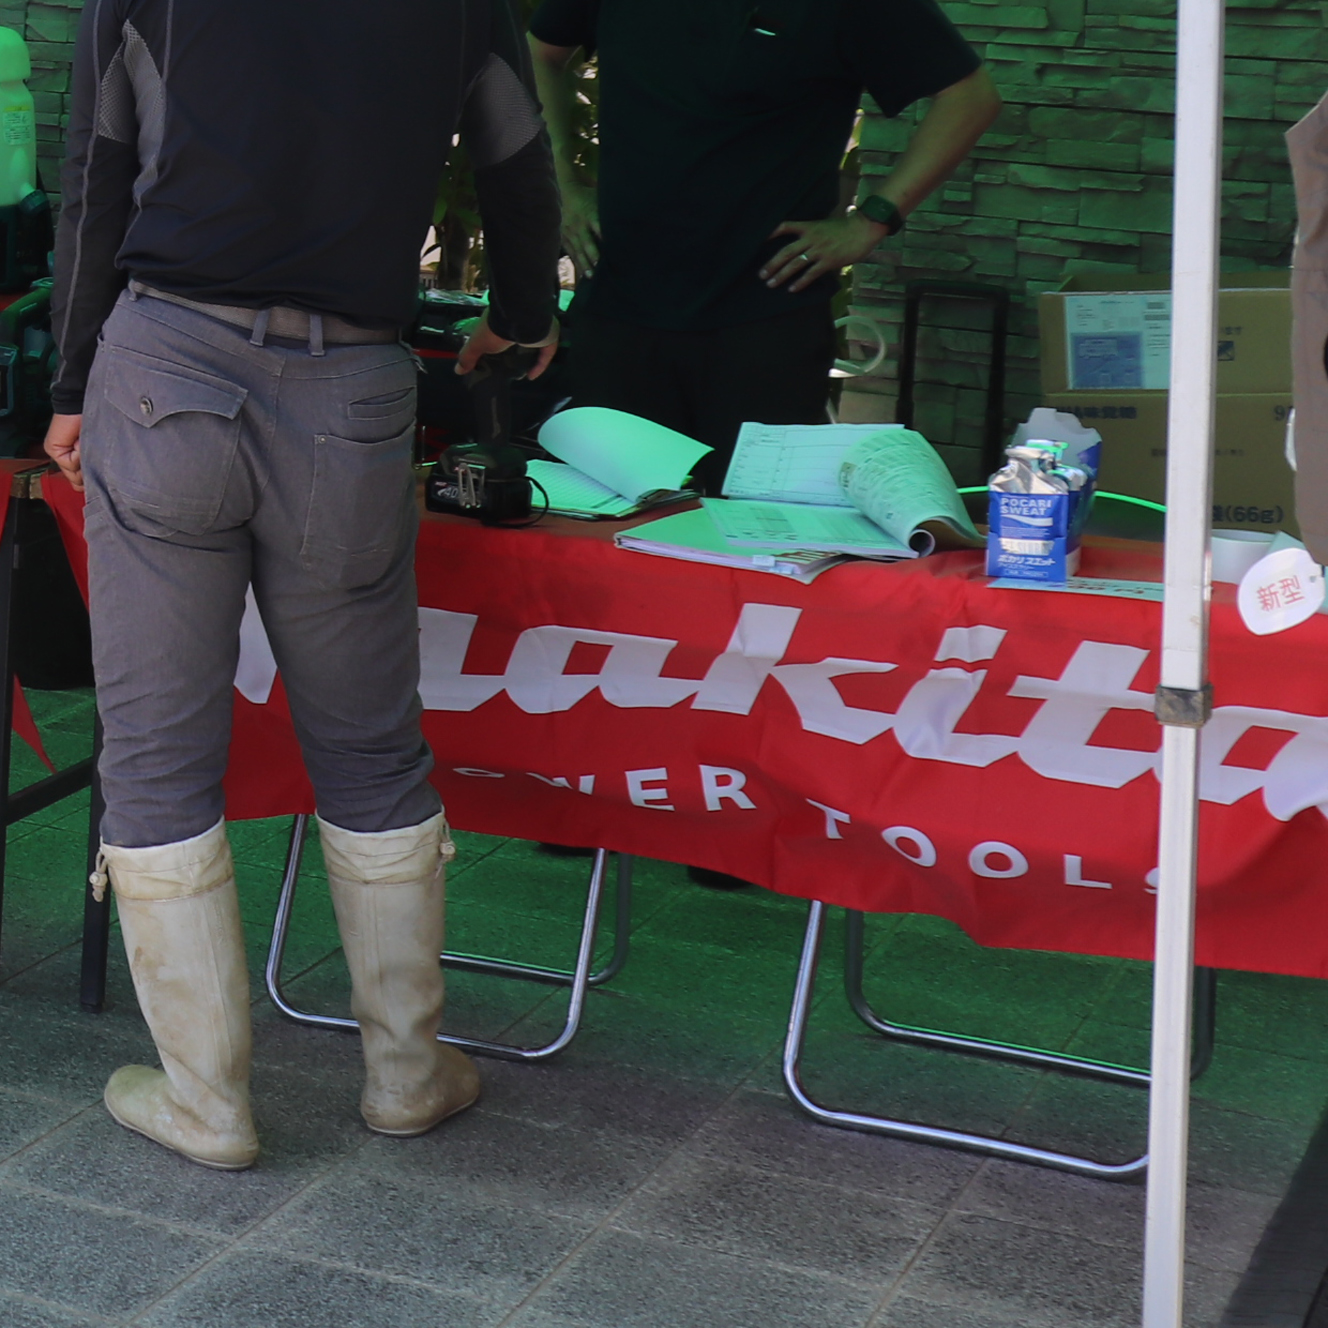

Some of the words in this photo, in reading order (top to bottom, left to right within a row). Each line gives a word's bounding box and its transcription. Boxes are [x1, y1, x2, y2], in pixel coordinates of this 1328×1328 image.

[1000, 497, 1052, 508] POCARI
[1000, 506, 1047, 516] SWEAT
[1257, 575, 1305, 611] 新型
